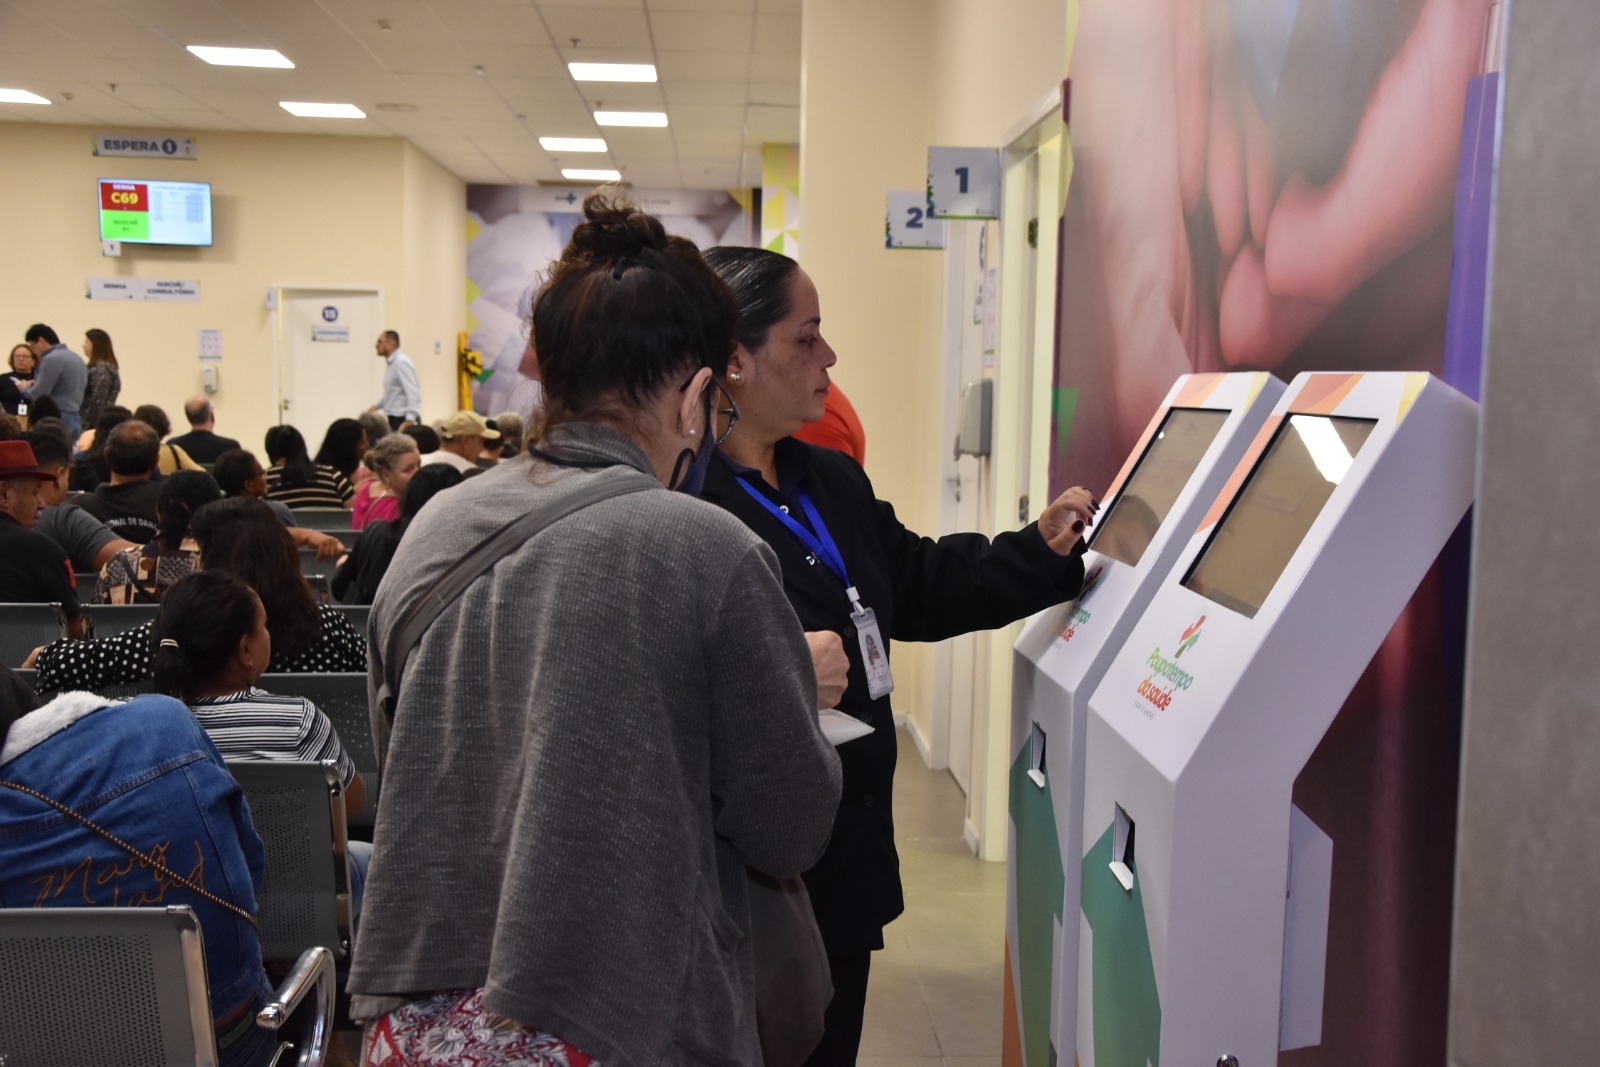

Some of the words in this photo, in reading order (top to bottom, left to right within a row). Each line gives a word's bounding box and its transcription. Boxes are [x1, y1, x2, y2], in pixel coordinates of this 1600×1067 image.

[103, 139, 159, 153] ESPERA
[955, 167, 969, 194] 1
[111, 192, 138, 204] C69
[905, 207, 924, 229] 2
[106, 517, 127, 528] ONAL
[127, 516, 138, 526] DE
[1145, 647, 1194, 692] Poupatempo
